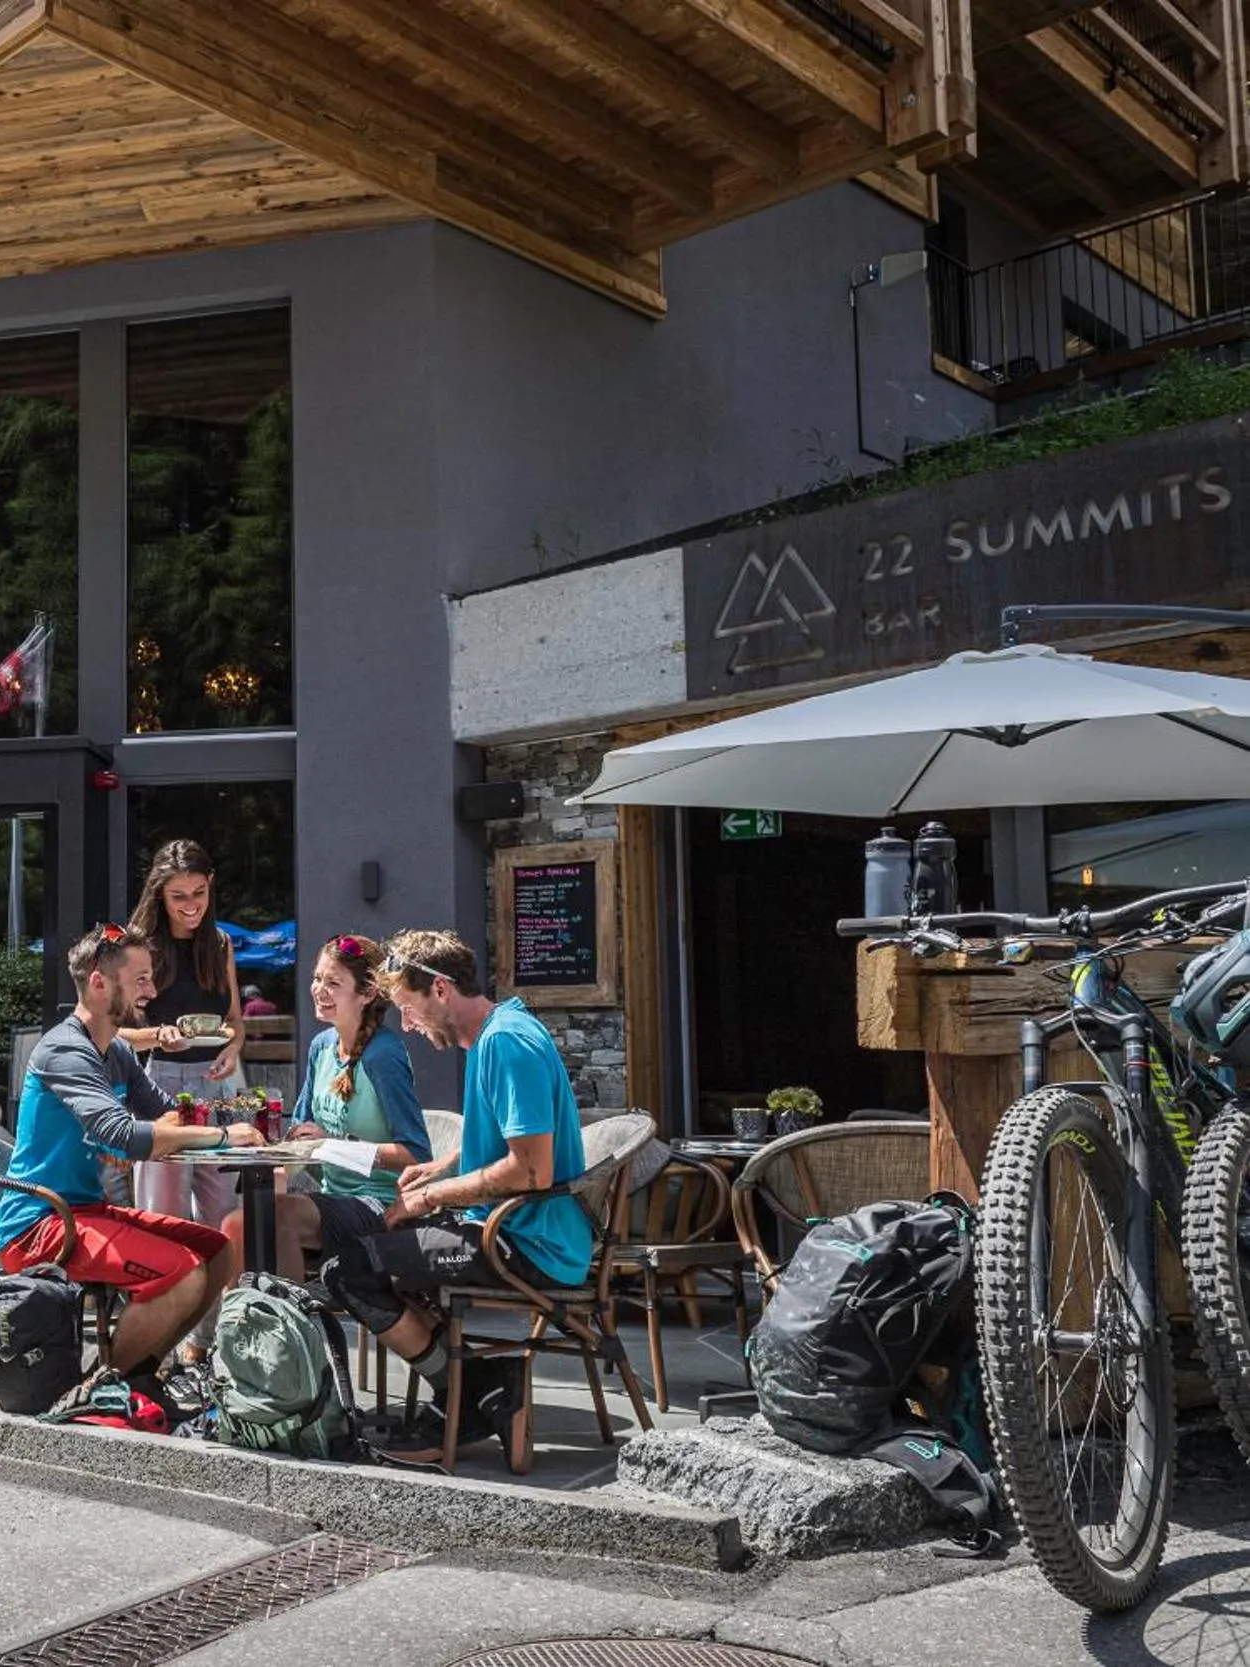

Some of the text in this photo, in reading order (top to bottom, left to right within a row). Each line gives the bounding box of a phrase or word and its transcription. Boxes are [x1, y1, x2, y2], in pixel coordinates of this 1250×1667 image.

[863, 466, 1233, 582] 22 SUMMITS
[863, 601, 943, 636] BAR
